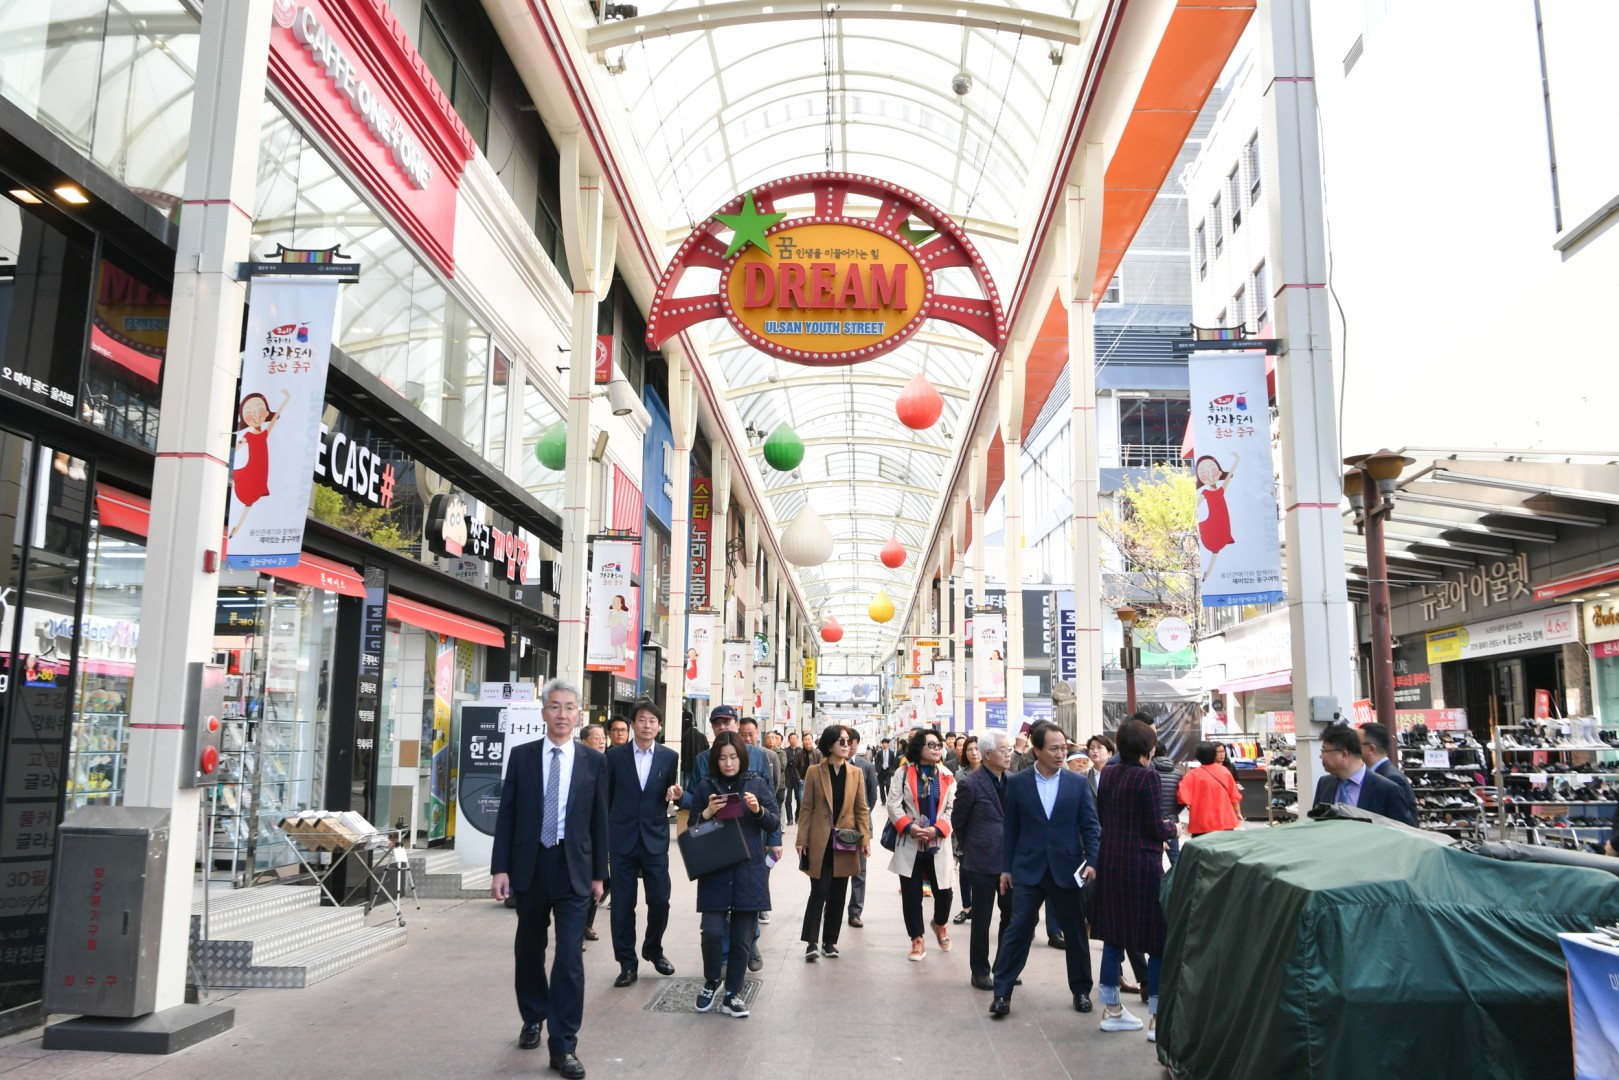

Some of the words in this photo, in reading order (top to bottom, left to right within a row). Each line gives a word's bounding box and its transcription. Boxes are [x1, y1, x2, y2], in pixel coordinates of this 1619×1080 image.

[297, 5, 356, 99] CAFFE
[776, 236, 797, 260] 꿈
[796, 248, 822, 260] 인생을
[824, 248, 869, 260] 이끌어가는
[871, 248, 879, 260] 힘
[742, 262, 909, 312] DREAM
[764, 320, 803, 335] ULSAN
[804, 321, 841, 335] YOUTH
[843, 321, 886, 335] STREET
[262, 346, 312, 360] 관광도시
[267, 361, 288, 375] 울산
[292, 360, 312, 374] 중구
[1, 366, 12, 381] 오
[13, 371, 31, 389] 마이
[32, 378, 50, 396] 골드
[50, 386, 75, 408] 울산점
[1207, 415, 1253, 426] 관광도시
[1215, 427, 1233, 439] 울산
[1236, 426, 1254, 438] 중구
[692, 483, 710, 520] 스타
[470, 516, 490, 557] 짱구
[492, 525, 530, 586] 게임장
[1226, 596, 1257, 605] 울산광역시
[510, 722, 547, 735] 1+1+1
[469, 742, 503, 760] 인생
